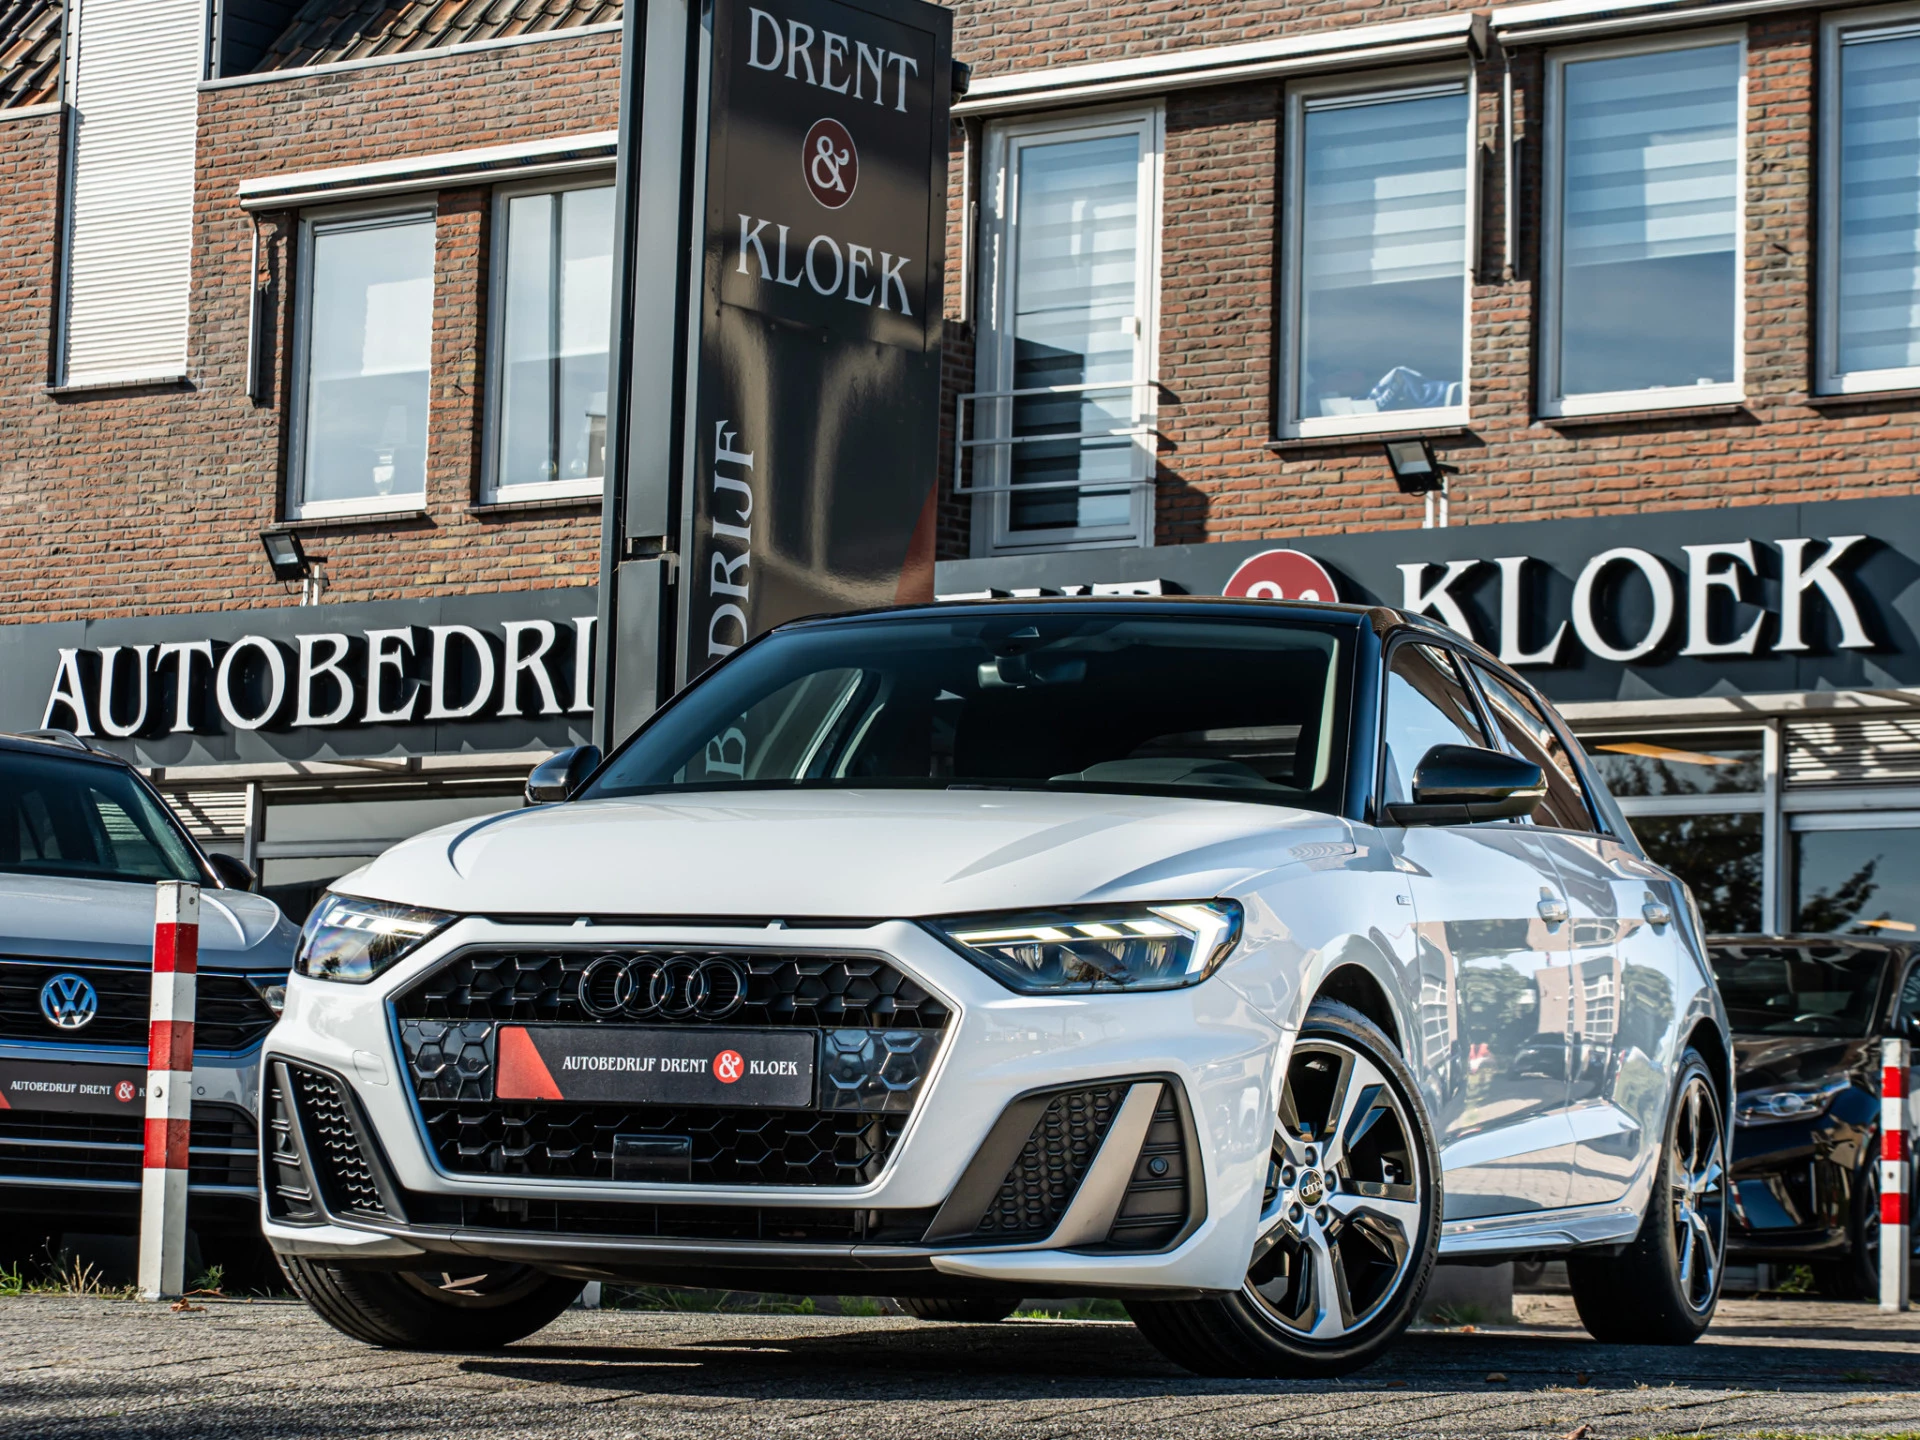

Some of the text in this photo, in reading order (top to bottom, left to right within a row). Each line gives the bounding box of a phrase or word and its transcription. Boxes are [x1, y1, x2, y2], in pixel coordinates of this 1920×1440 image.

[747, 7, 918, 113] DRENT
[811, 135, 849, 193] &
[736, 213, 913, 316] KLOEK
[1396, 534, 1875, 665] KLOEK
[10, 1080, 77, 1093] AUTOBEDRIJF
[80, 1084, 111, 1095] DRENT
[118, 1082, 133, 1099] &
[562, 1054, 798, 1079] AUTOBEDRIJF DRENT & KLOEK
